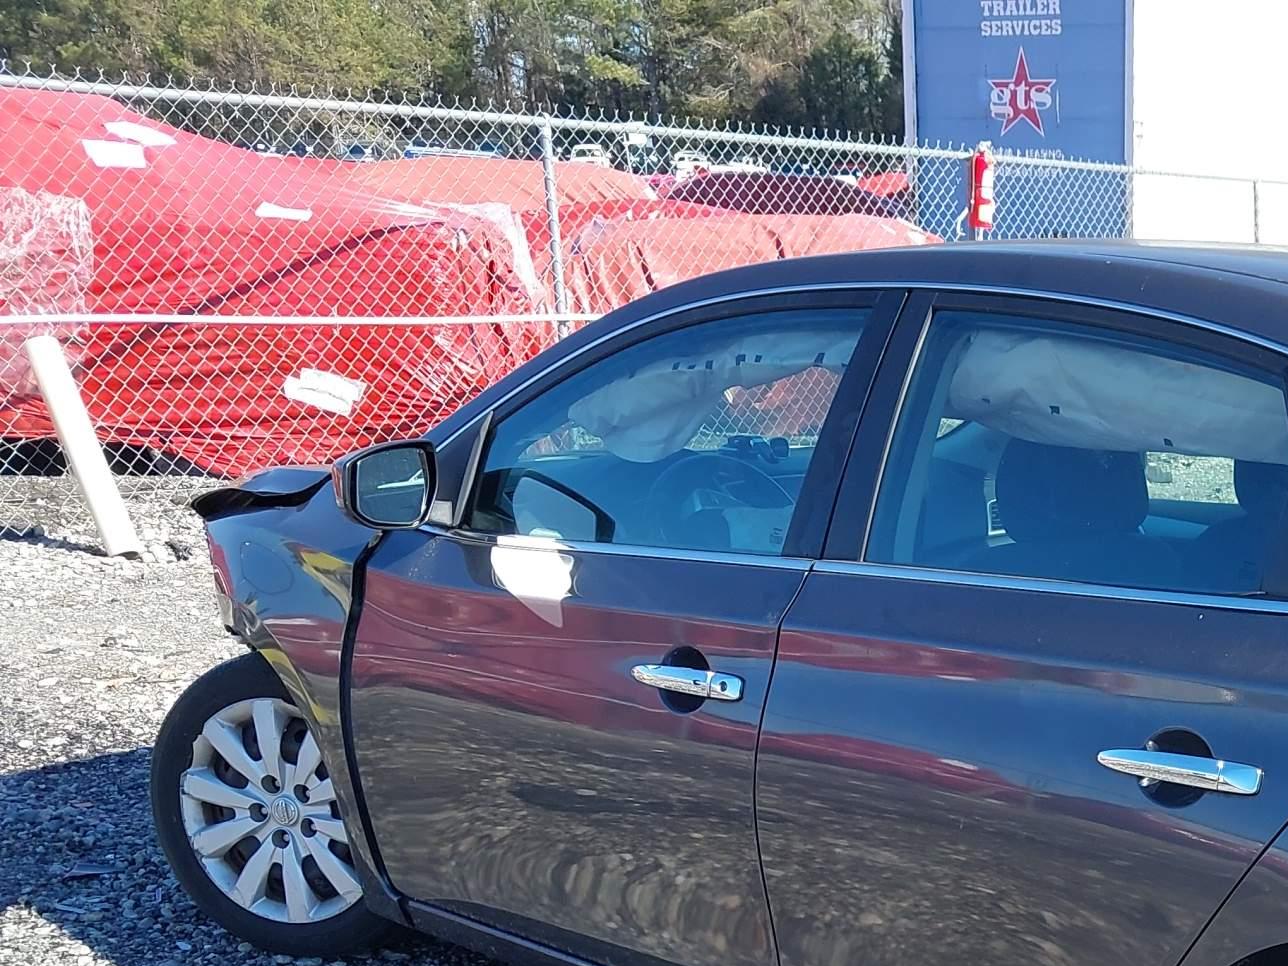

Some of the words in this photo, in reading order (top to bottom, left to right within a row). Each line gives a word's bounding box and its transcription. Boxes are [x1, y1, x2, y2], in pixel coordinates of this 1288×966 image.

[980, 0, 1061, 16] TRAILER
[980, 20, 1062, 36] SERVICES
[990, 80, 1052, 120] gts
